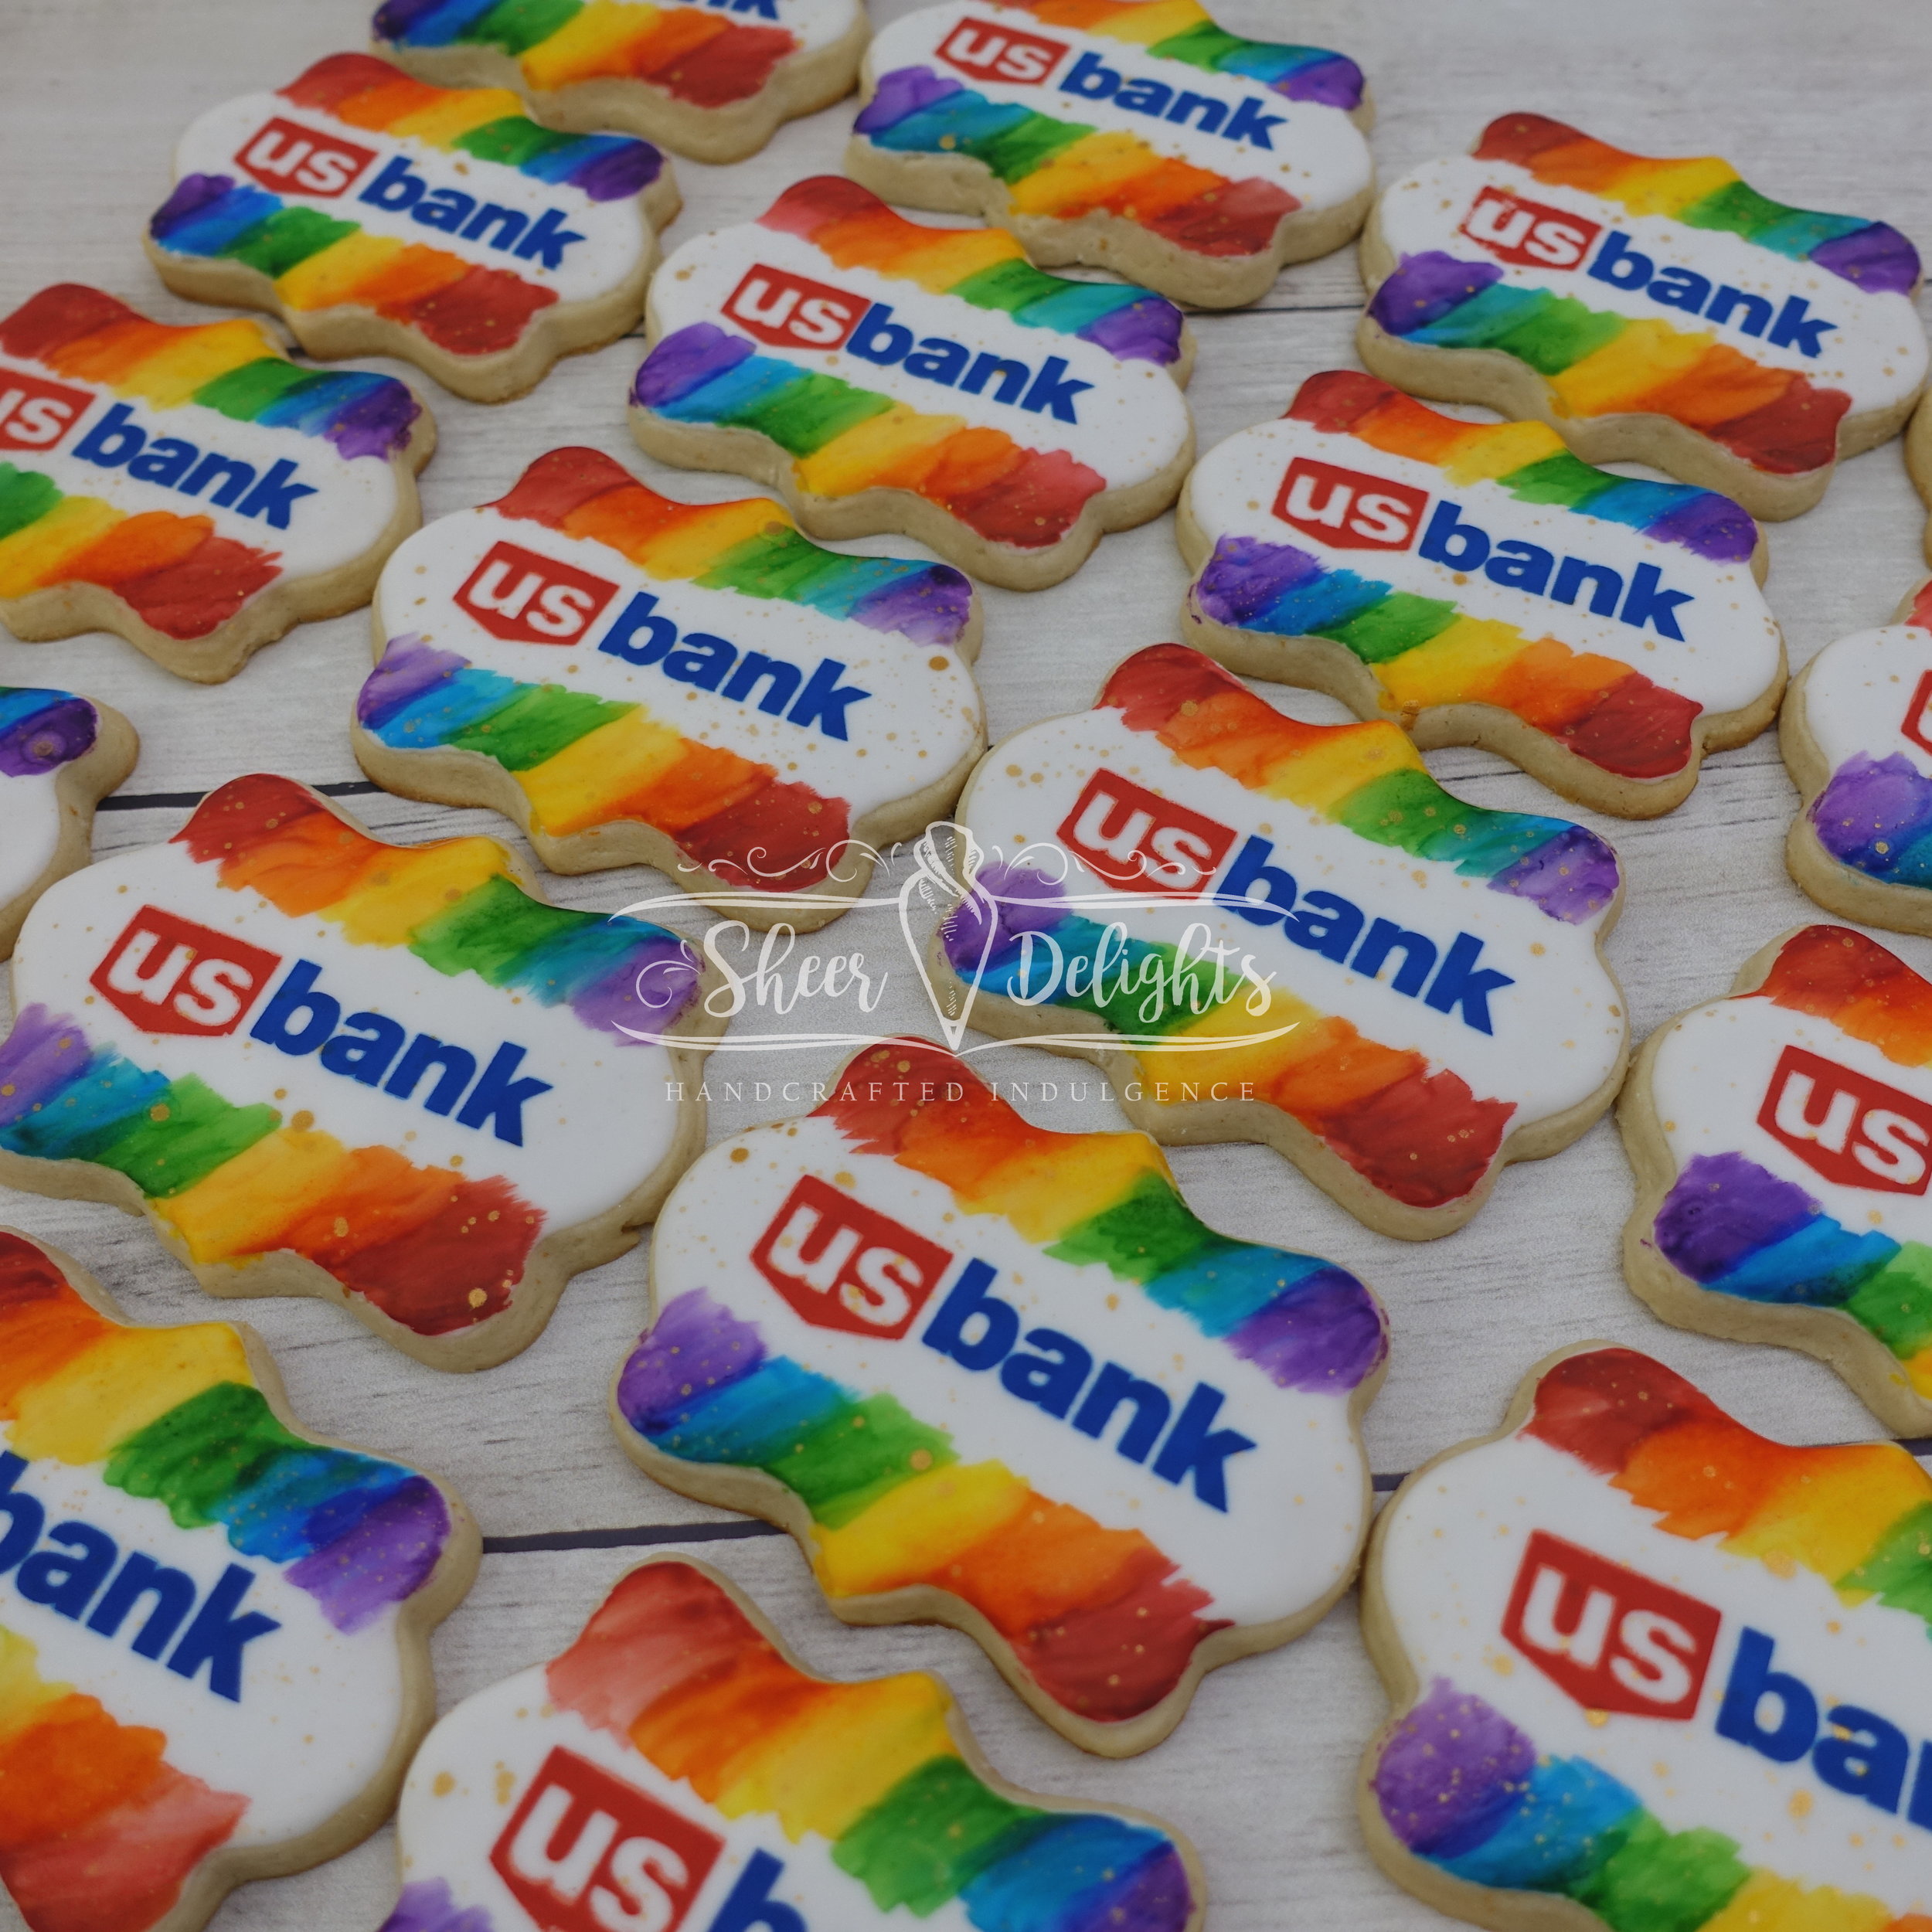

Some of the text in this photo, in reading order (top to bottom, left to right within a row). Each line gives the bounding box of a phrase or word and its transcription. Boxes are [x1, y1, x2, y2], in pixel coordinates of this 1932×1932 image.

[947, 28, 1286, 150] us bank
[247, 131, 586, 270] us bank
[1468, 199, 1837, 358] us bank
[733, 278, 1094, 424] us bank
[72, 403, 318, 529] bank
[1285, 474, 1695, 642] us bank
[468, 560, 872, 742] us bank
[1073, 790, 1515, 1036] us bank
[107, 929, 554, 1148] us bank
[1774, 1070, 1930, 1185] us
[767, 1202, 1257, 1513] us bank
[1521, 1566, 1932, 1832] us ba
[509, 1784, 689, 1932] us
